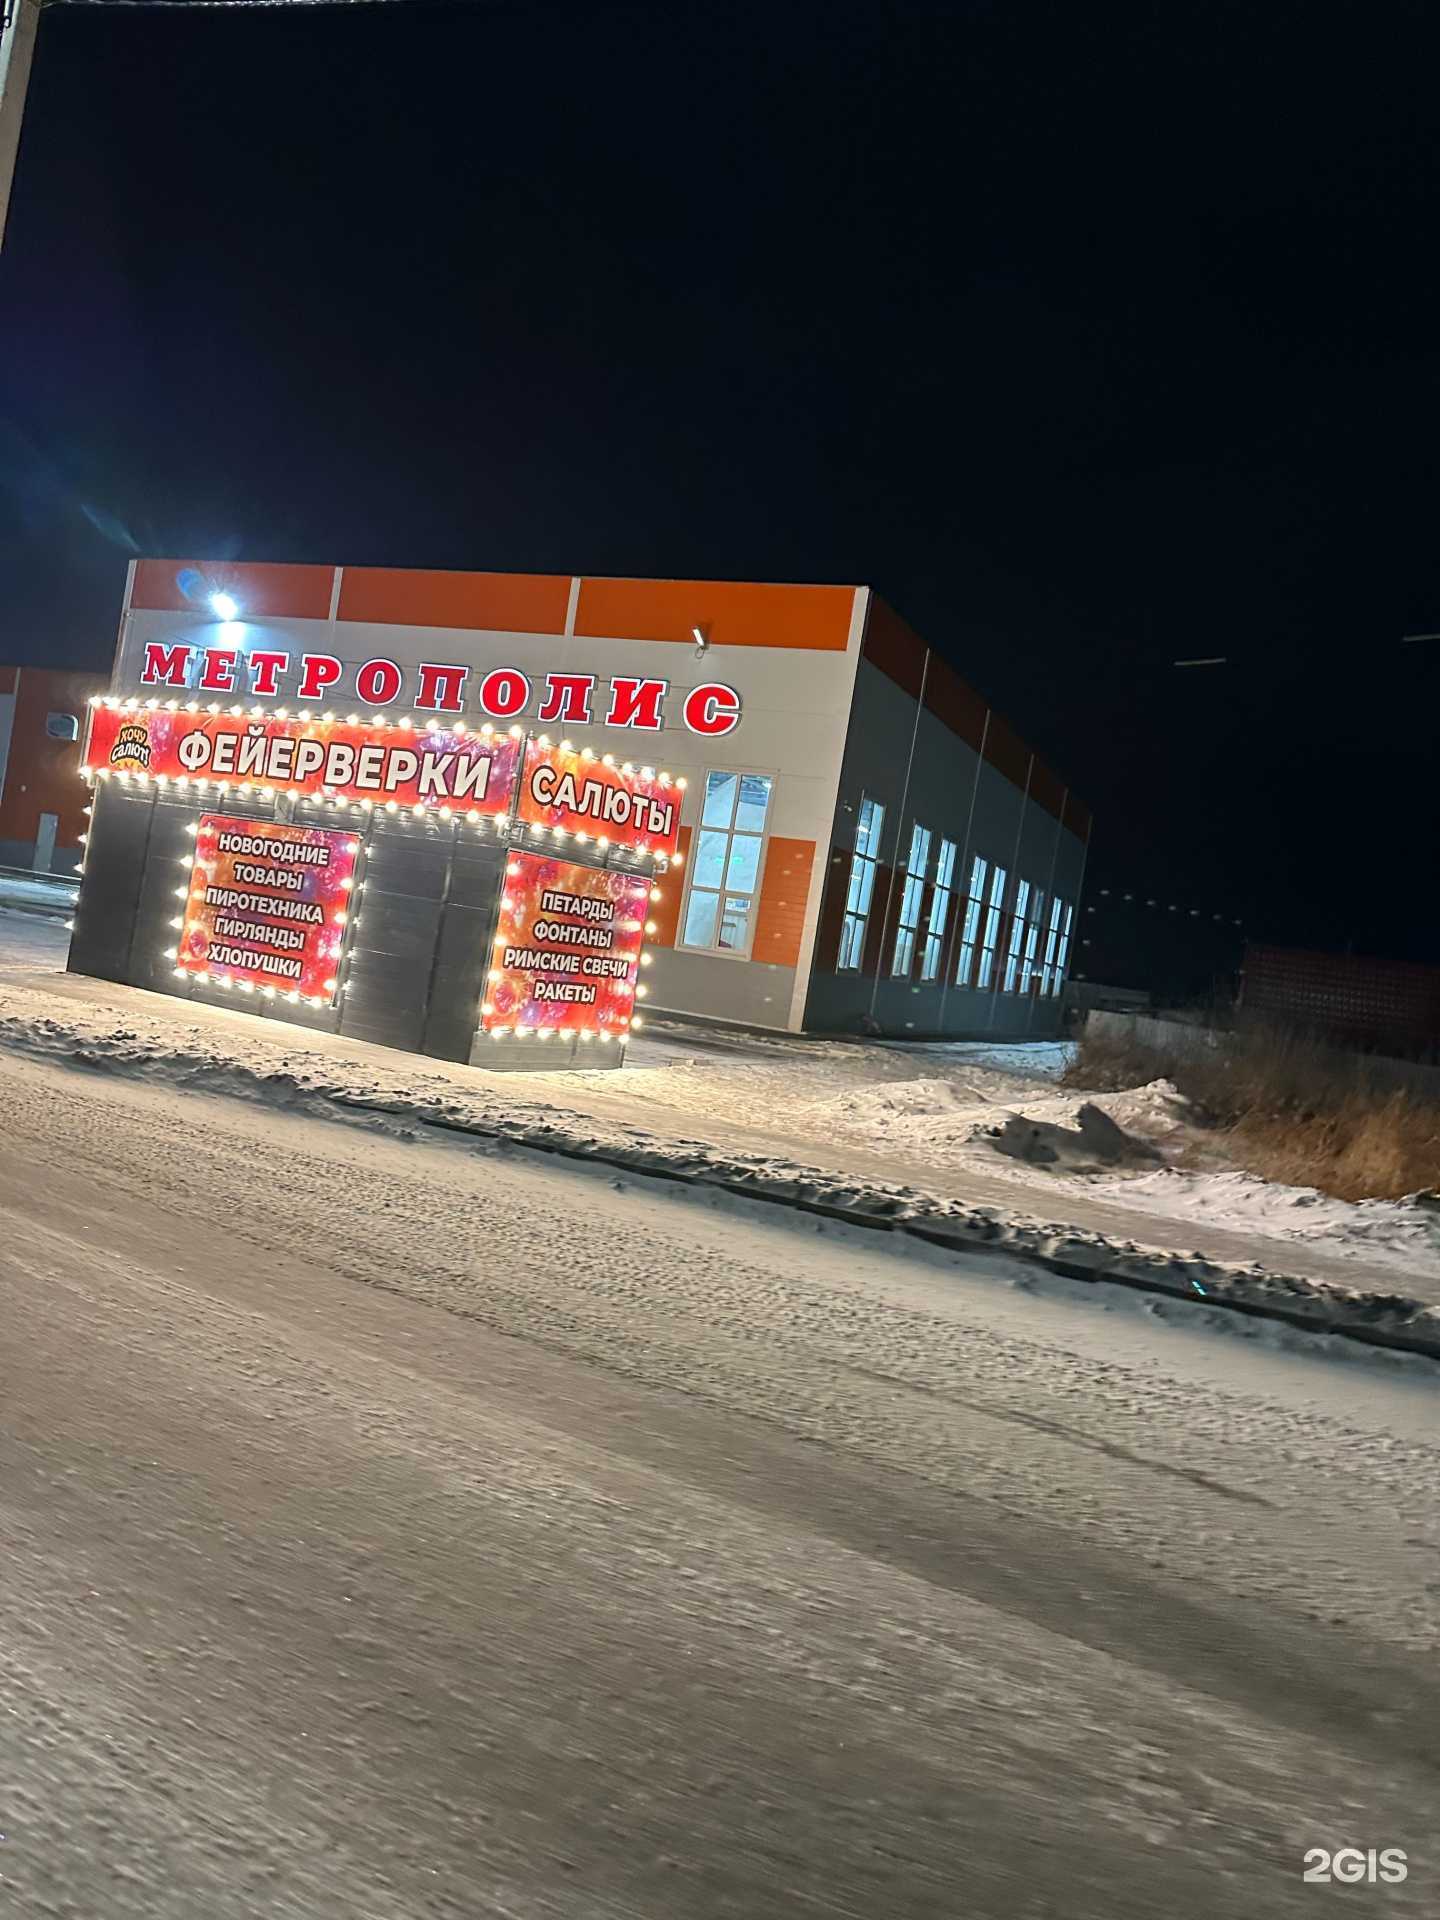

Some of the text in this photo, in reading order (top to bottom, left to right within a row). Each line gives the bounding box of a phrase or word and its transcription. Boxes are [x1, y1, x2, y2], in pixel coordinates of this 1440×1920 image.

[141, 642, 740, 736] МЕТРОПОЛИС
[121, 728, 147, 743] ХОЧУ
[178, 725, 492, 800] ФЕЙЕРВЕРКИ
[531, 765, 673, 836] САЛЮТЫ
[218, 833, 329, 866] НОВОГОДНИЕ
[234, 863, 303, 891] ТОВАРЫ
[206, 886, 324, 924] ПИРОТЕХНИКА
[542, 892, 614, 921] ПЕТАРДЫ
[214, 917, 304, 950] ГИРЛЯНДЫ
[534, 921, 613, 948] ФОНТАНЫ
[208, 943, 302, 978] ХЛОПУШКИ
[503, 948, 629, 978] РИМСКИЕ СВЕЧИ
[534, 982, 596, 1003] РАКЕТЫ
